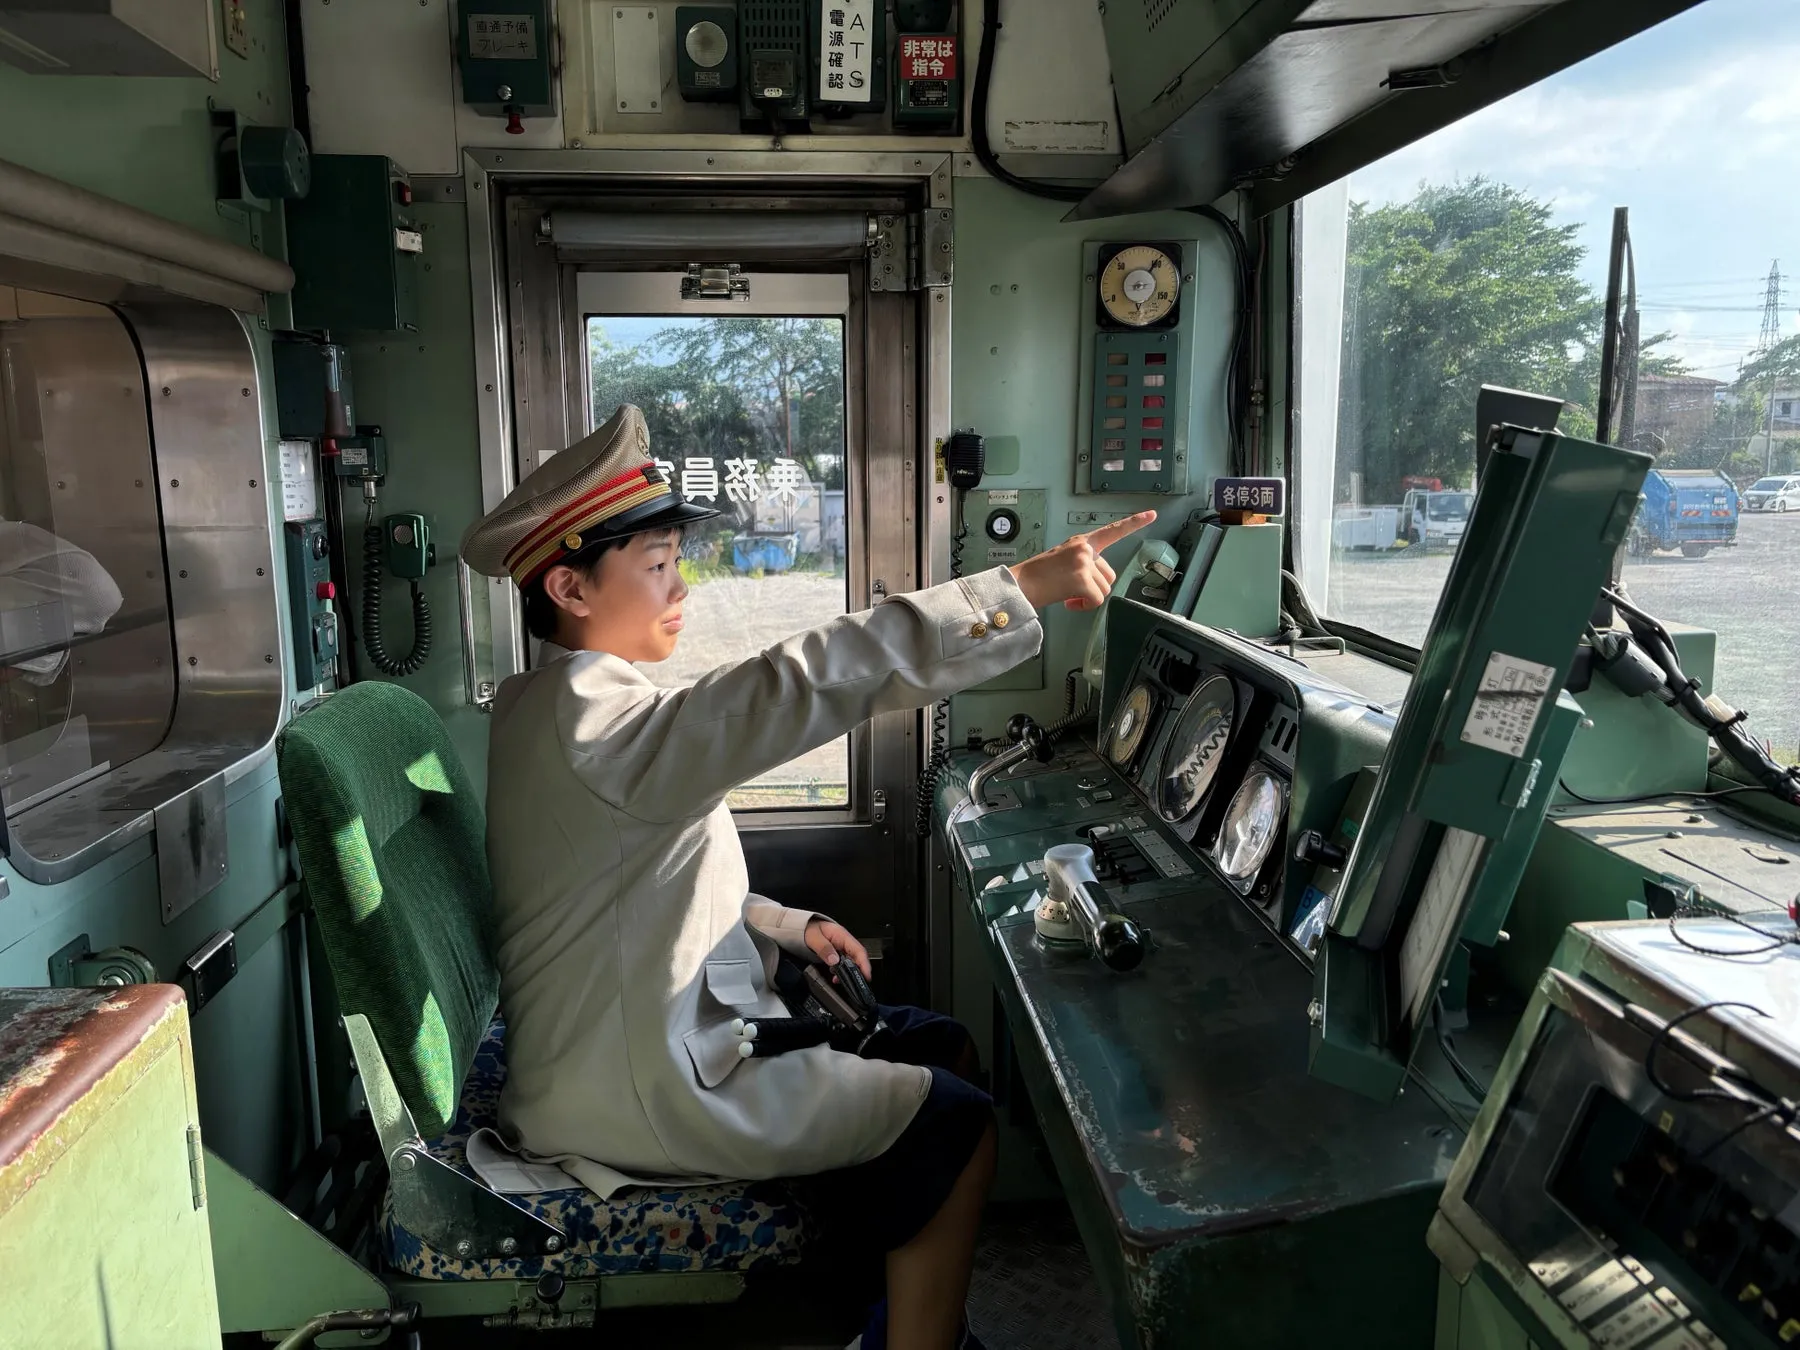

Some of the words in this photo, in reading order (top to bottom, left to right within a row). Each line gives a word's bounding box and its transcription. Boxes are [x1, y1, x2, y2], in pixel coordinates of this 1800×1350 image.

[475, 20, 528, 34] 直通予備
[828, 9, 845, 89] 電源確認
[849, 13, 865, 88] ATS
[903, 39, 953, 57] 非常は
[911, 59, 945, 76] 指令
[1117, 262, 1125, 270] 50
[1111, 294, 1116, 302] 0
[1157, 291, 1168, 300] 150
[1222, 486, 1274, 508] 各停3両
[853, 970, 867, 989] SONY
